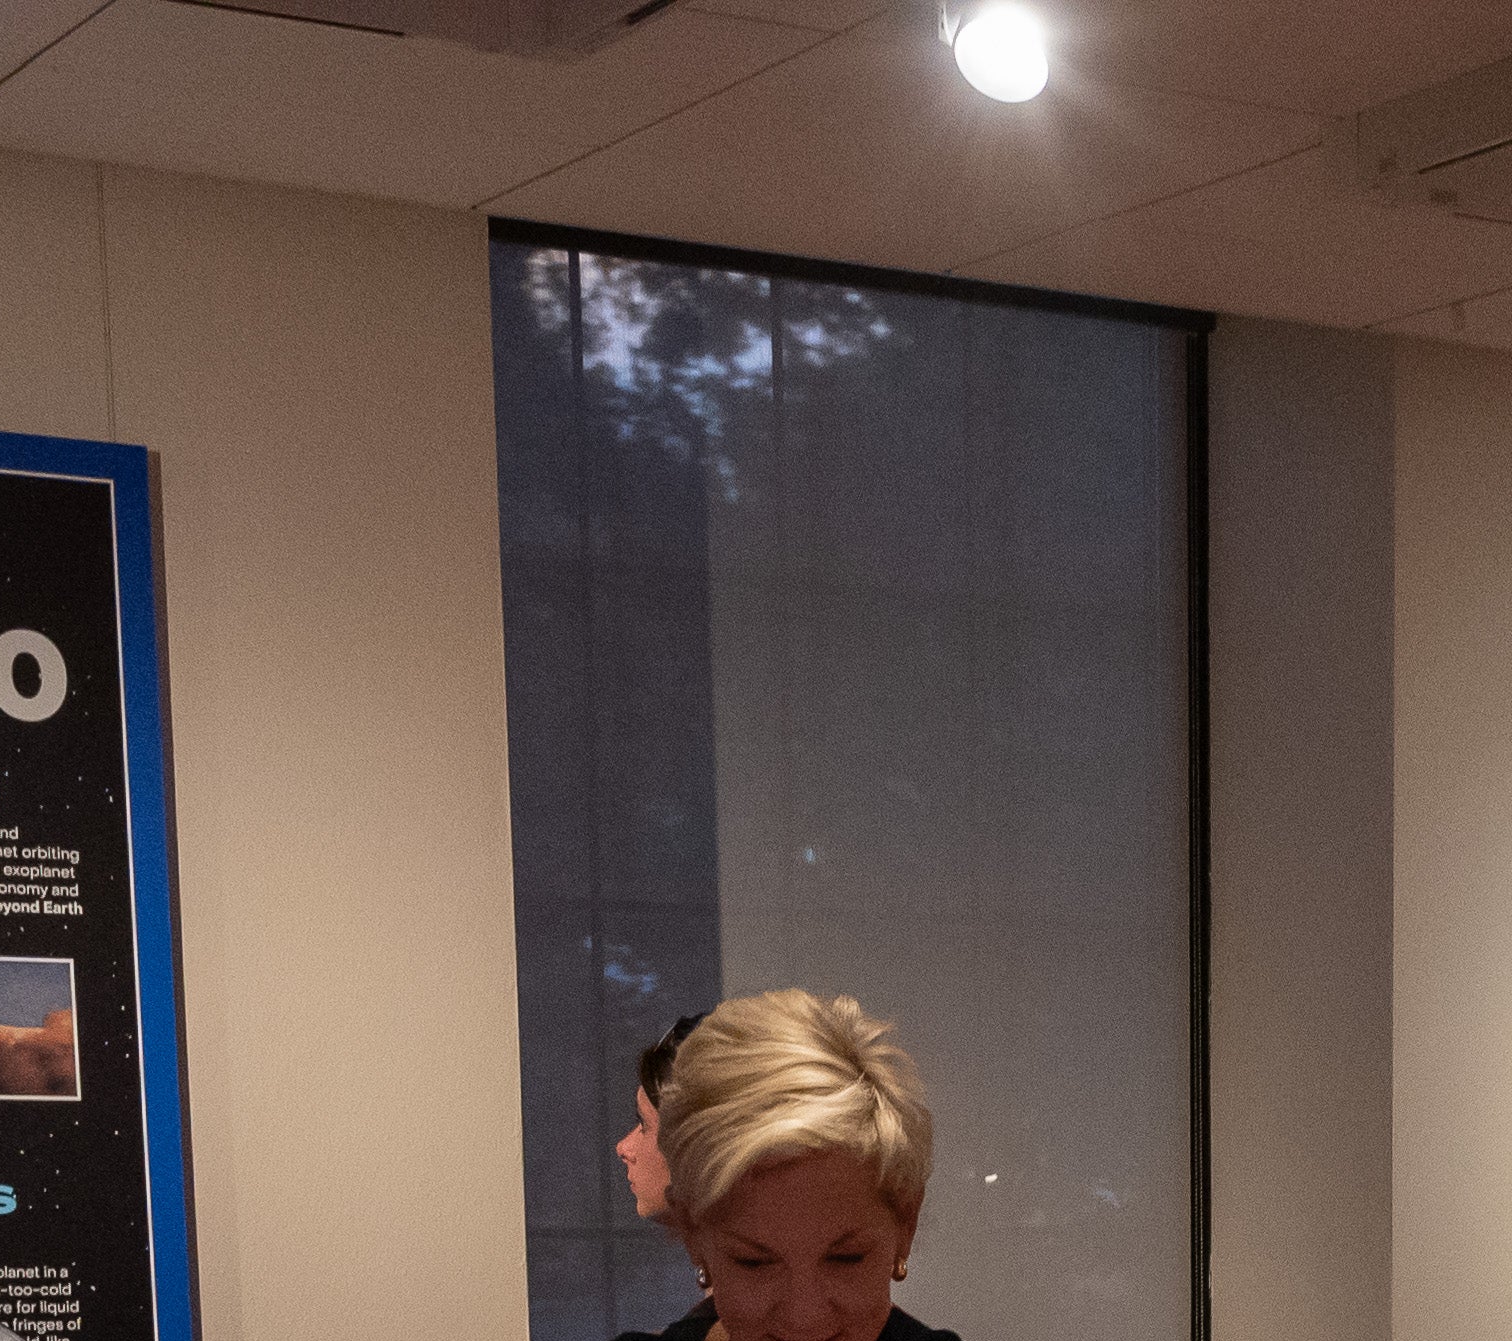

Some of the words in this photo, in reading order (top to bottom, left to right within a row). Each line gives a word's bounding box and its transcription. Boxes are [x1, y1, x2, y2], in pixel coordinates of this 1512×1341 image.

[21, 845, 80, 864] orbiting
[51, 883, 80, 897] and
[42, 900, 84, 916] Earth
